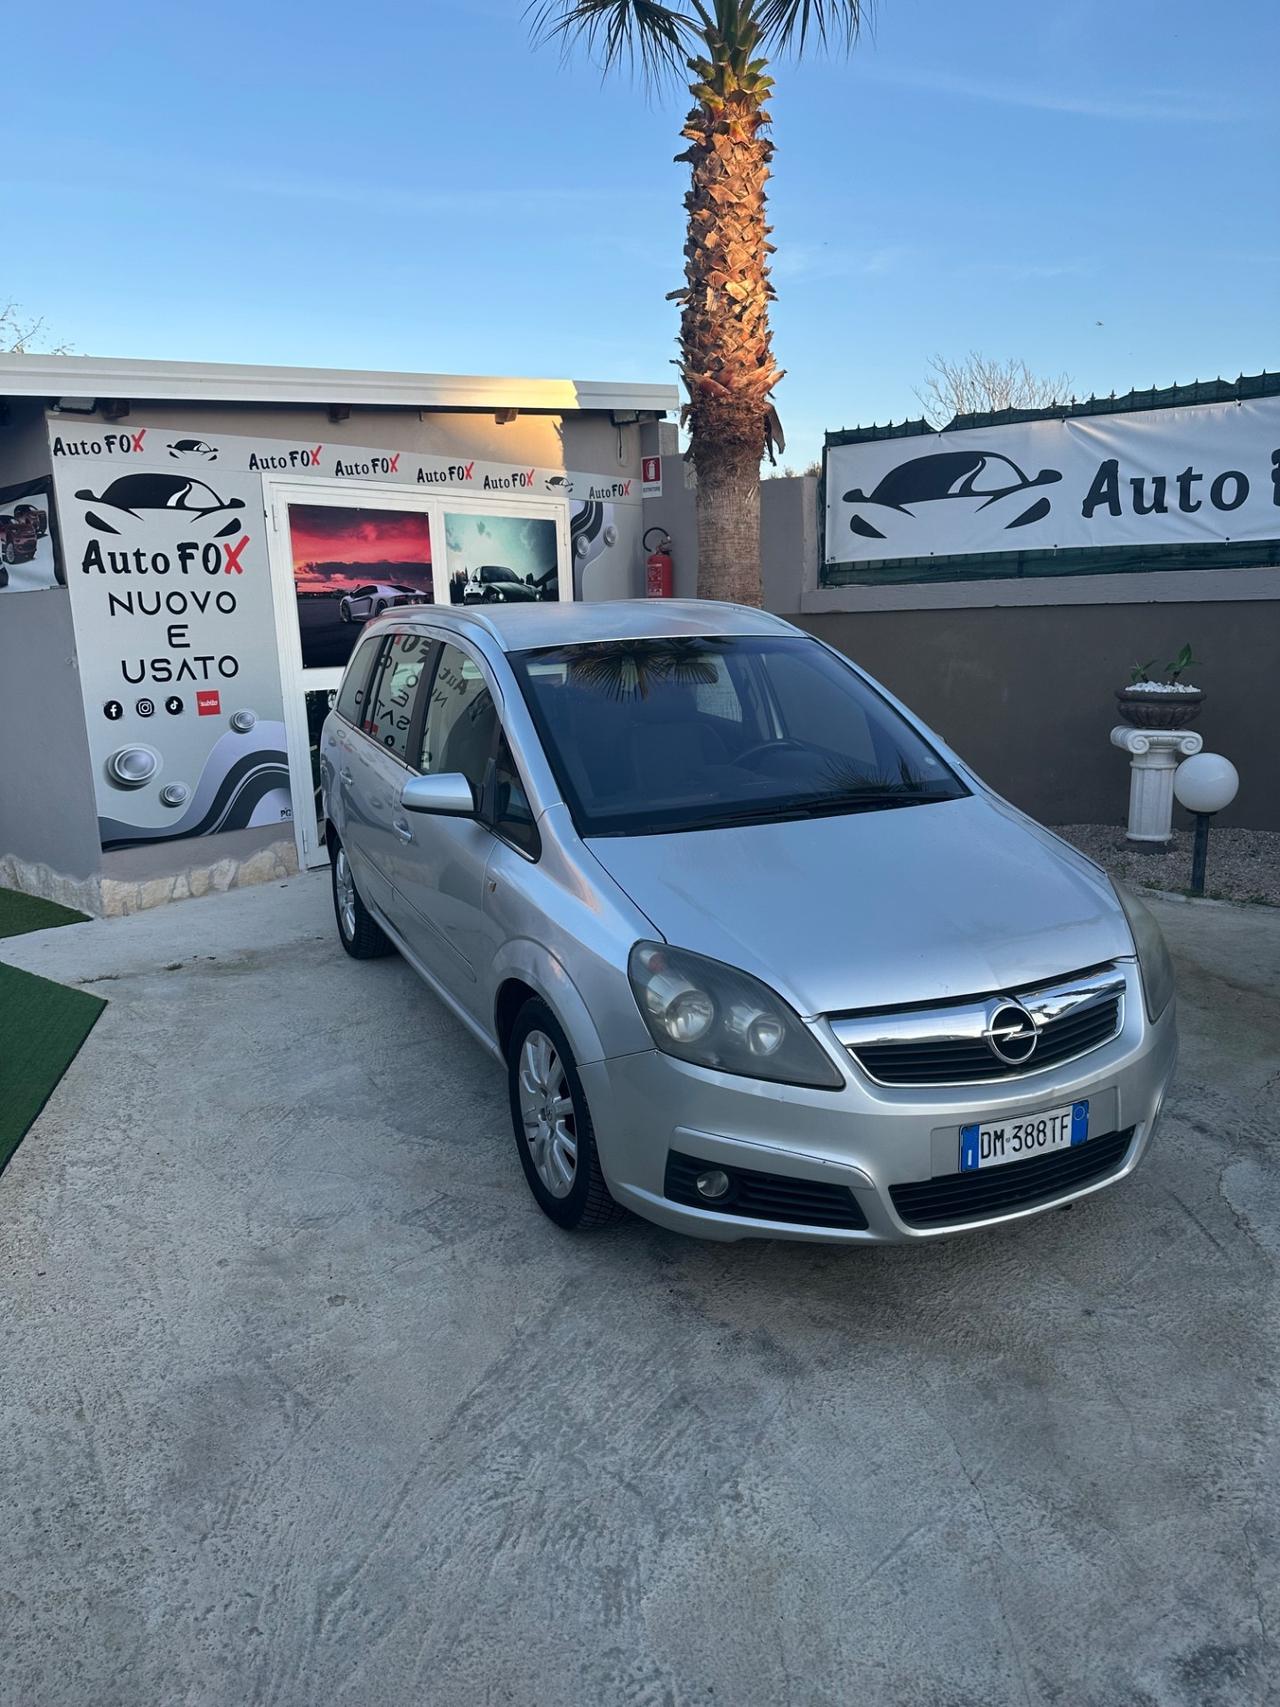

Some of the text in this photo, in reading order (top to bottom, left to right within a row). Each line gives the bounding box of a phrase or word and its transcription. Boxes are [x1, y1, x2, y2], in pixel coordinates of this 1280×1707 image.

[53, 428, 146, 456] Auto FOX
[249, 445, 322, 470] Auto FOX
[335, 453, 400, 476] Auto FOX
[417, 462, 474, 483] Auto FOX
[483, 469, 535, 490] Auto FOX
[589, 486, 610, 499] Auto
[611, 480, 631, 497] FOX
[1082, 459, 1250, 519] Auto
[82, 535, 250, 575] Auto FOX
[108, 591, 237, 616] NUOVO
[167, 624, 191, 648] E
[121, 655, 240, 684] USATO
